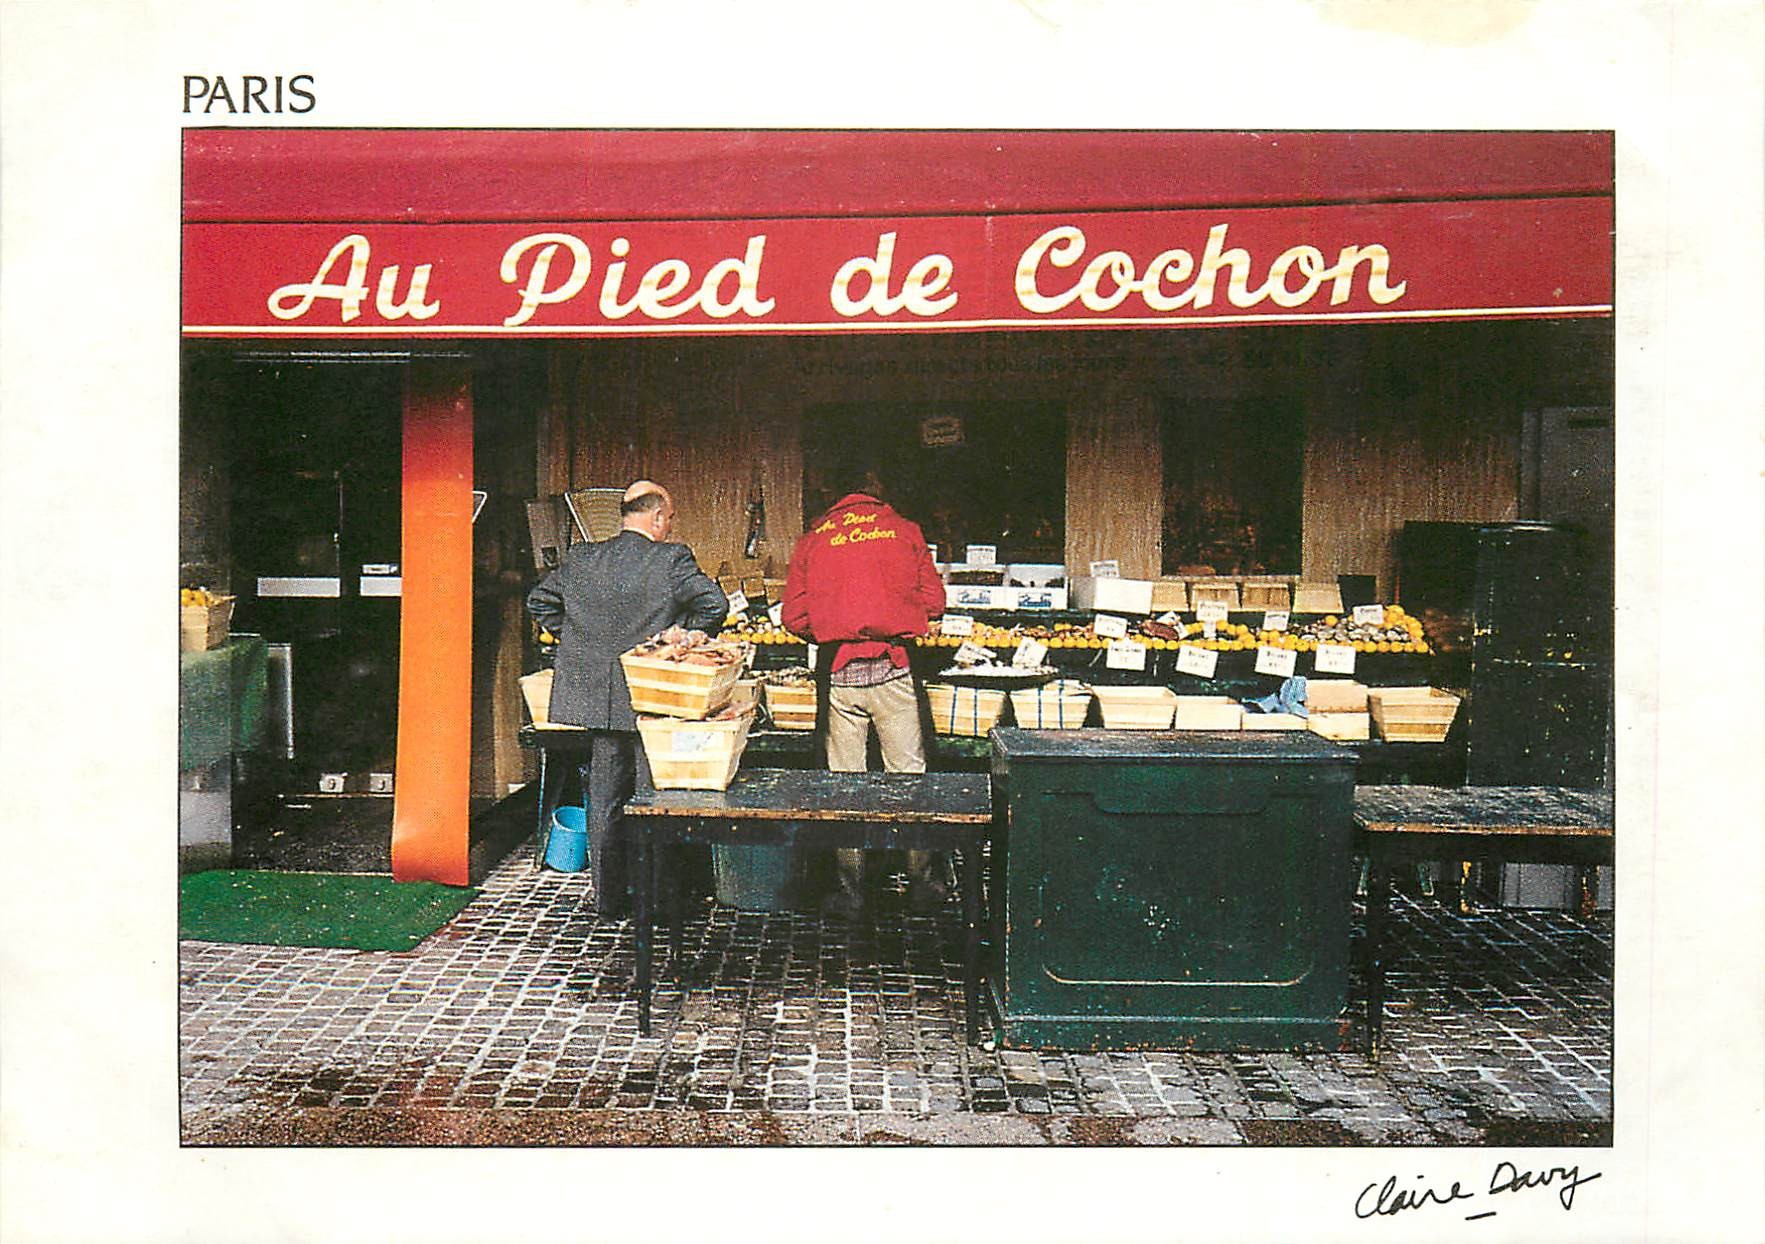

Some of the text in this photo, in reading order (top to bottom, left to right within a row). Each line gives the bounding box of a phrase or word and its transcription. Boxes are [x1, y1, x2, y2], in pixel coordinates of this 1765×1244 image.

[267, 223, 1407, 327] Au Pied de Cochon
[829, 531, 848, 547] de
